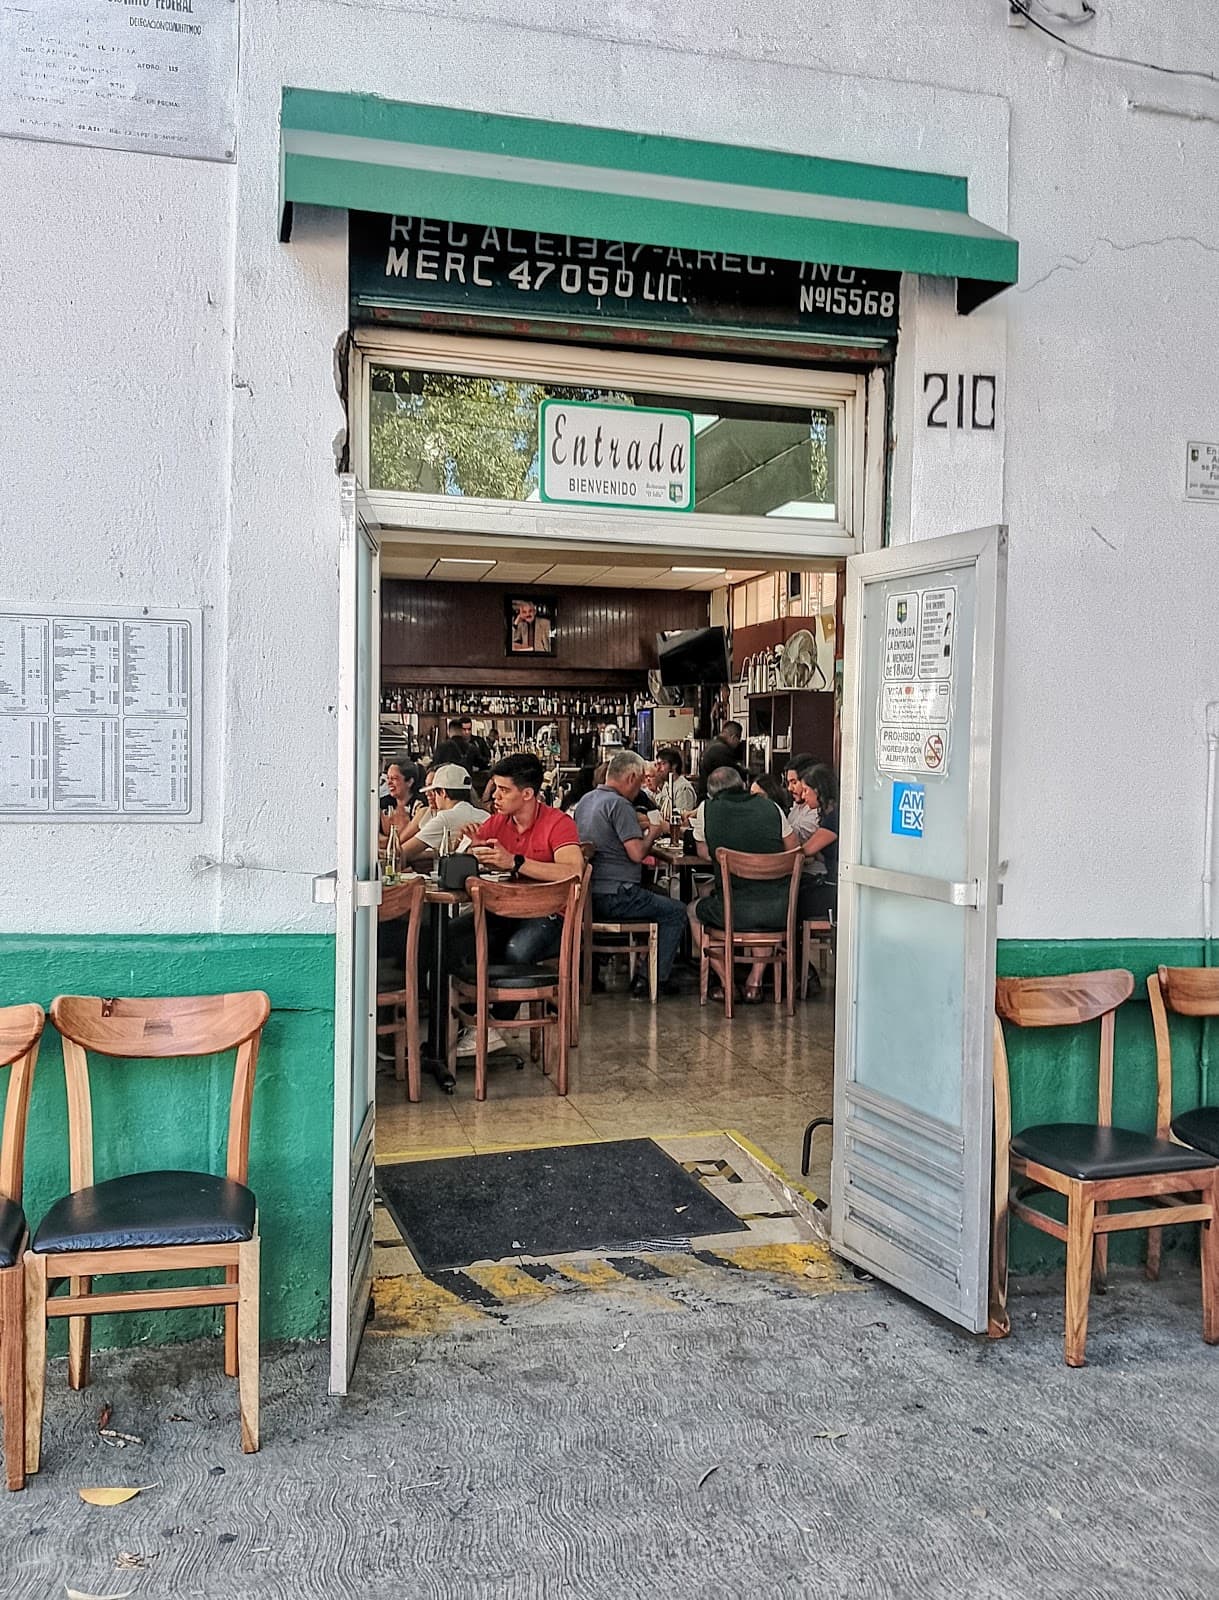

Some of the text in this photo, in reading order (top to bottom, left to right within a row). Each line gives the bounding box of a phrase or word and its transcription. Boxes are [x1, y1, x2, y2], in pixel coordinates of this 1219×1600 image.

[508, 260, 634, 298] 47050
[924, 372, 996, 431] 210
[551, 413, 686, 475] Entrada
[569, 477, 637, 496] BIENVENIDO
[887, 626, 916, 638] PROHIBIDA
[887, 640, 914, 651] LA ENTRADA
[892, 653, 914, 664] MENORES
[885, 665, 893, 676] DE
[893, 663, 901, 677] 18
[901, 663, 913, 676] AÑOS
[883, 730, 921, 742] PROHIBIDO
[885, 754, 917, 763] ALIMENTOS
[904, 810, 922, 827] EX
